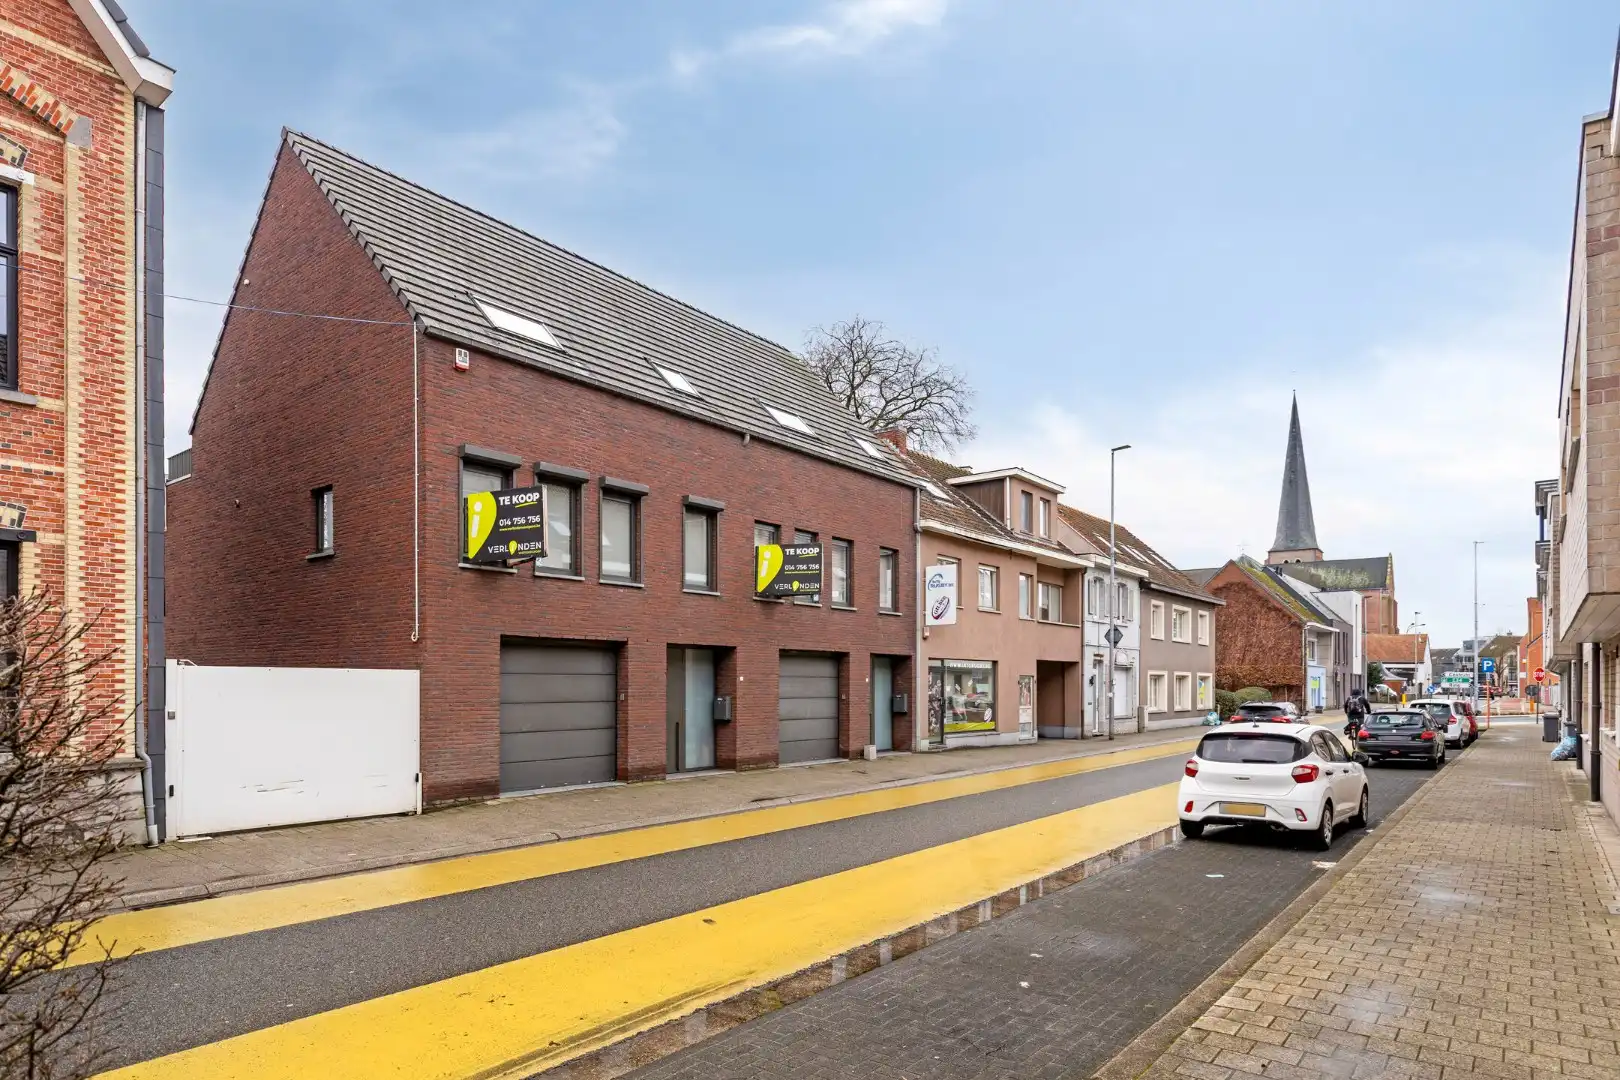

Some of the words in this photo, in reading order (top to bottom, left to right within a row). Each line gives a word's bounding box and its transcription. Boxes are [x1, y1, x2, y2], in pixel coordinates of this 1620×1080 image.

[499, 496, 511, 506] TE
[512, 492, 540, 504] KOOP
[499, 518, 512, 526] 014
[513, 516, 526, 524] 756
[528, 514, 540, 523] 756
[1484, 660, 1492, 670] P
